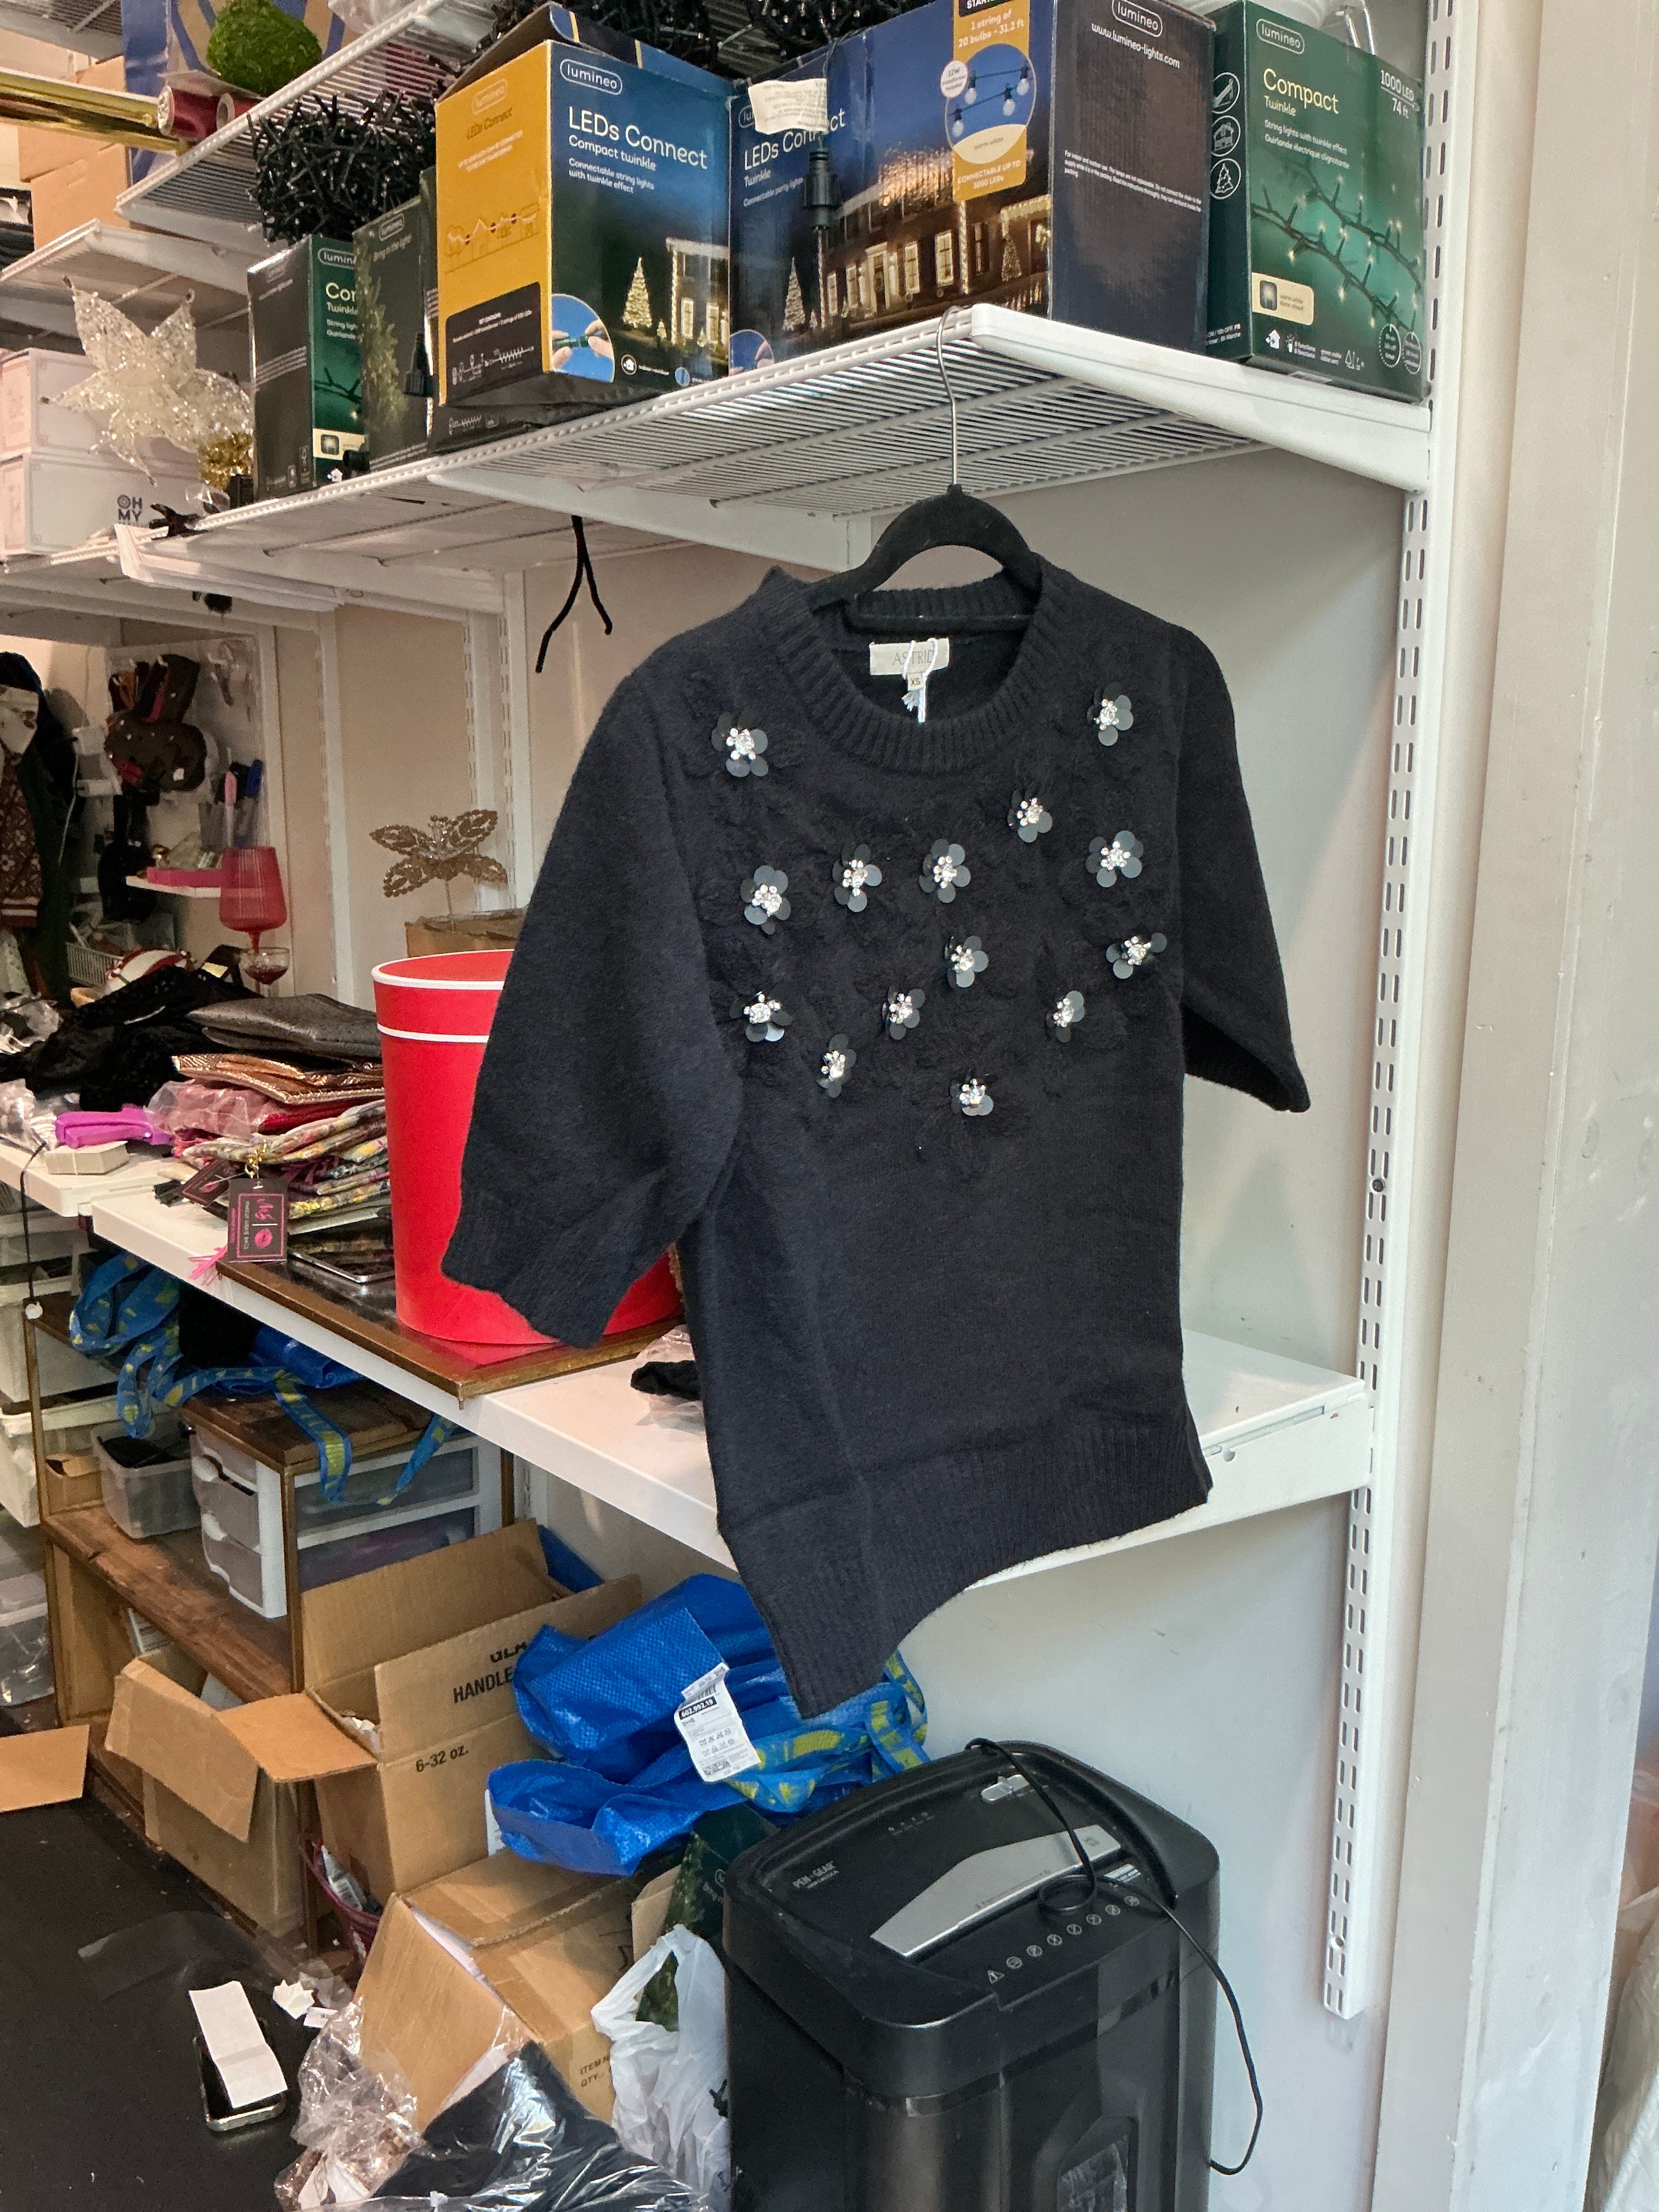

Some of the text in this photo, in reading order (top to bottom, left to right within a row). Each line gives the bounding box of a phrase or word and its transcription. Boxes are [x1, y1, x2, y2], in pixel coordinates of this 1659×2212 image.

[971, 9, 1012, 30] 1 string of
[1117, 5, 1158, 31] lumineo
[958, 37, 968, 48] 20
[970, 31, 992, 44] bulbs
[1000, 21, 1015, 35] 31.2
[1017, 19, 1024, 29] ft
[1091, 22, 1180, 69] www.lumineo-lights.com
[1261, 26, 1301, 48] lumineo
[567, 64, 617, 89] lumineo
[949, 66, 960, 77] 12W
[1380, 70, 1401, 93] 1000
[1263, 69, 1339, 114] Compact
[1264, 95, 1296, 117] Twinkle
[1392, 98, 1409, 119] 74 ft
[568, 106, 708, 170] LEDs Connect
[744, 108, 845, 171] LEDs Conct
[1265, 119, 1283, 134] String
[1283, 125, 1299, 138] lights
[1300, 132, 1312, 142] with
[1312, 136, 1332, 149] twinkle
[569, 135, 656, 171] Compact twinkle
[569, 158, 654, 190] Connectable string lights
[569, 170, 634, 194] with twinkle effect
[744, 168, 771, 187] Twinkle
[957, 165, 1001, 184] CONNECTABLE
[1012, 160, 1020, 168] TO
[117, 494, 143, 509] OH
[118, 509, 143, 522] MY
[892, 650, 935, 666] ASTRID
[910, 678, 921, 686] XS
[453, 1667, 515, 1703] HANDLE
[415, 1745, 469, 1773] 6-32 oz.
